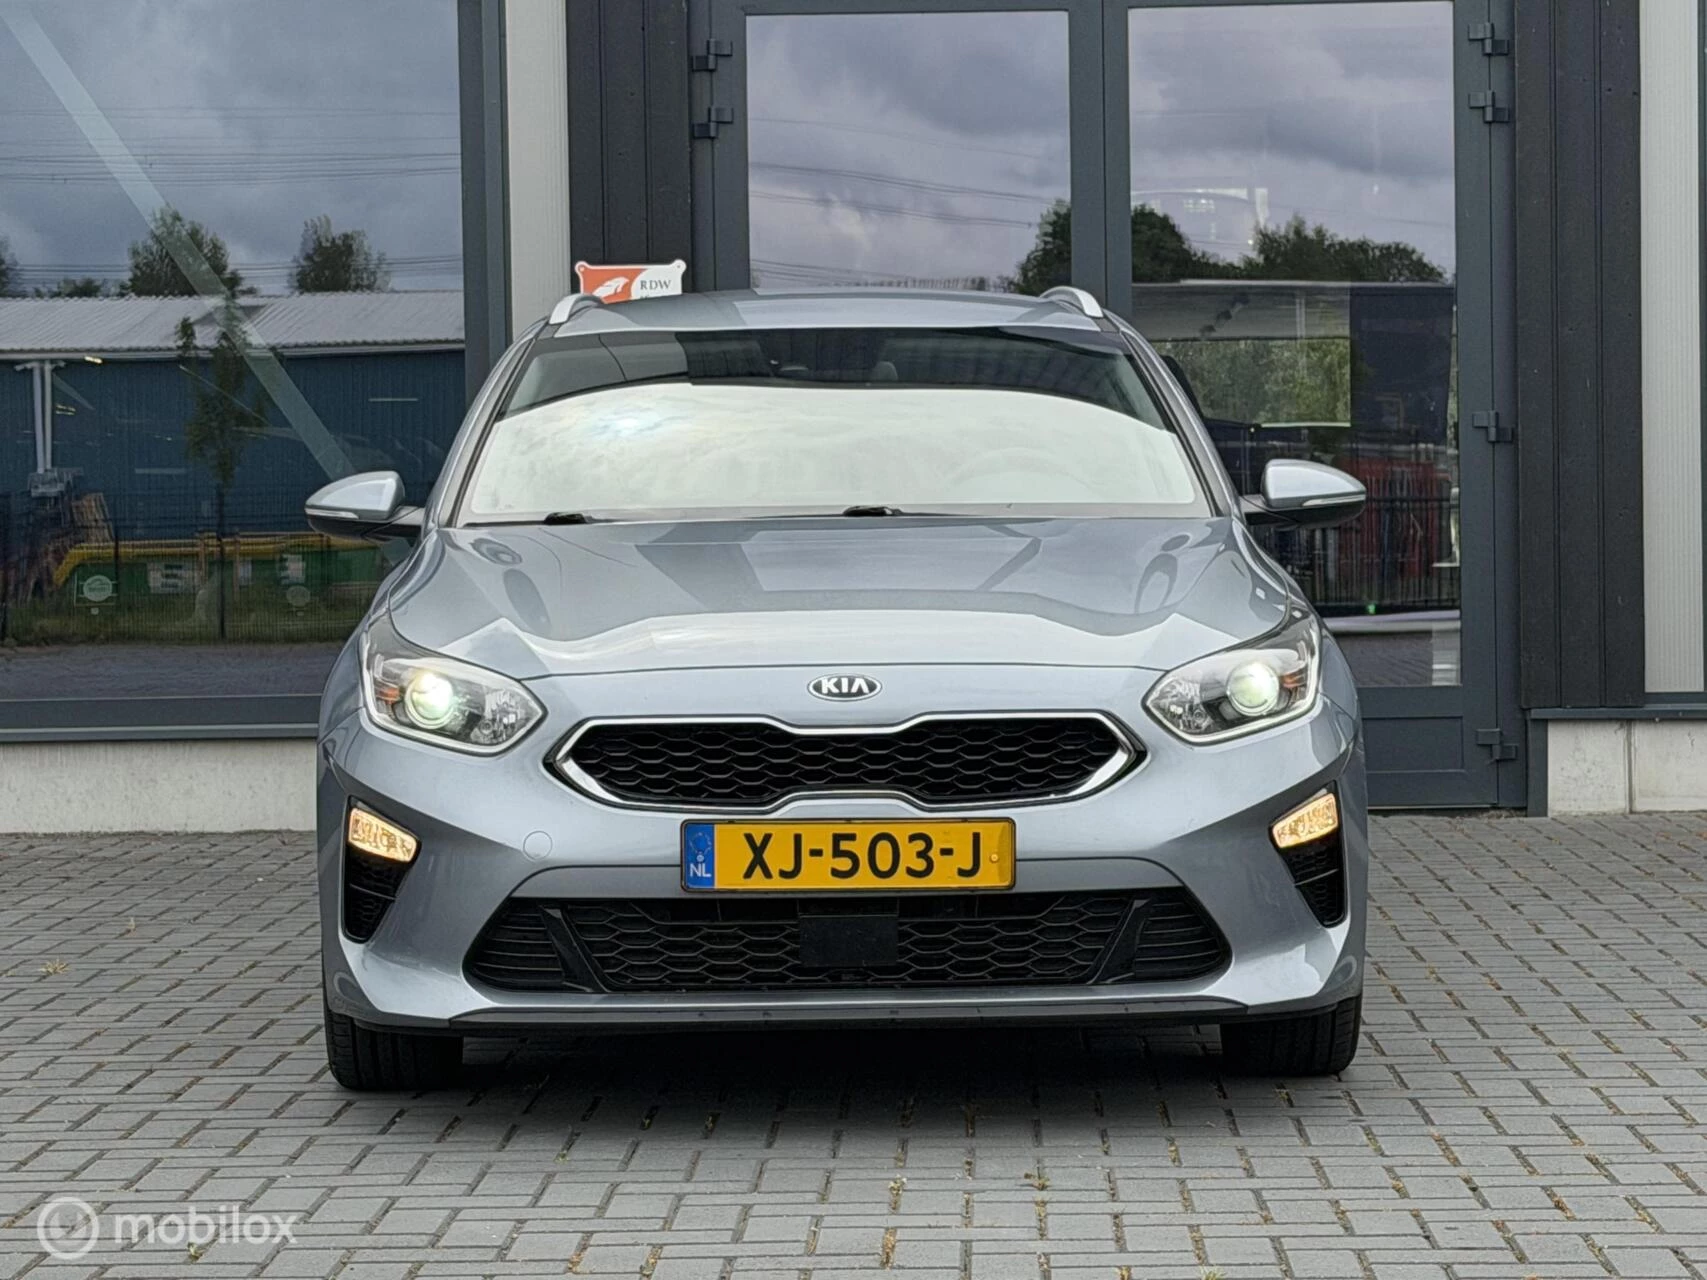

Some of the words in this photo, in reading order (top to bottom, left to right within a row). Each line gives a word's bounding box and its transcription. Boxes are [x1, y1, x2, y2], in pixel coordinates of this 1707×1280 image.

[640, 280, 671, 290] RDW
[821, 677, 870, 694] KIA
[743, 832, 981, 880] XJ-503-J
[689, 863, 712, 878] NL
